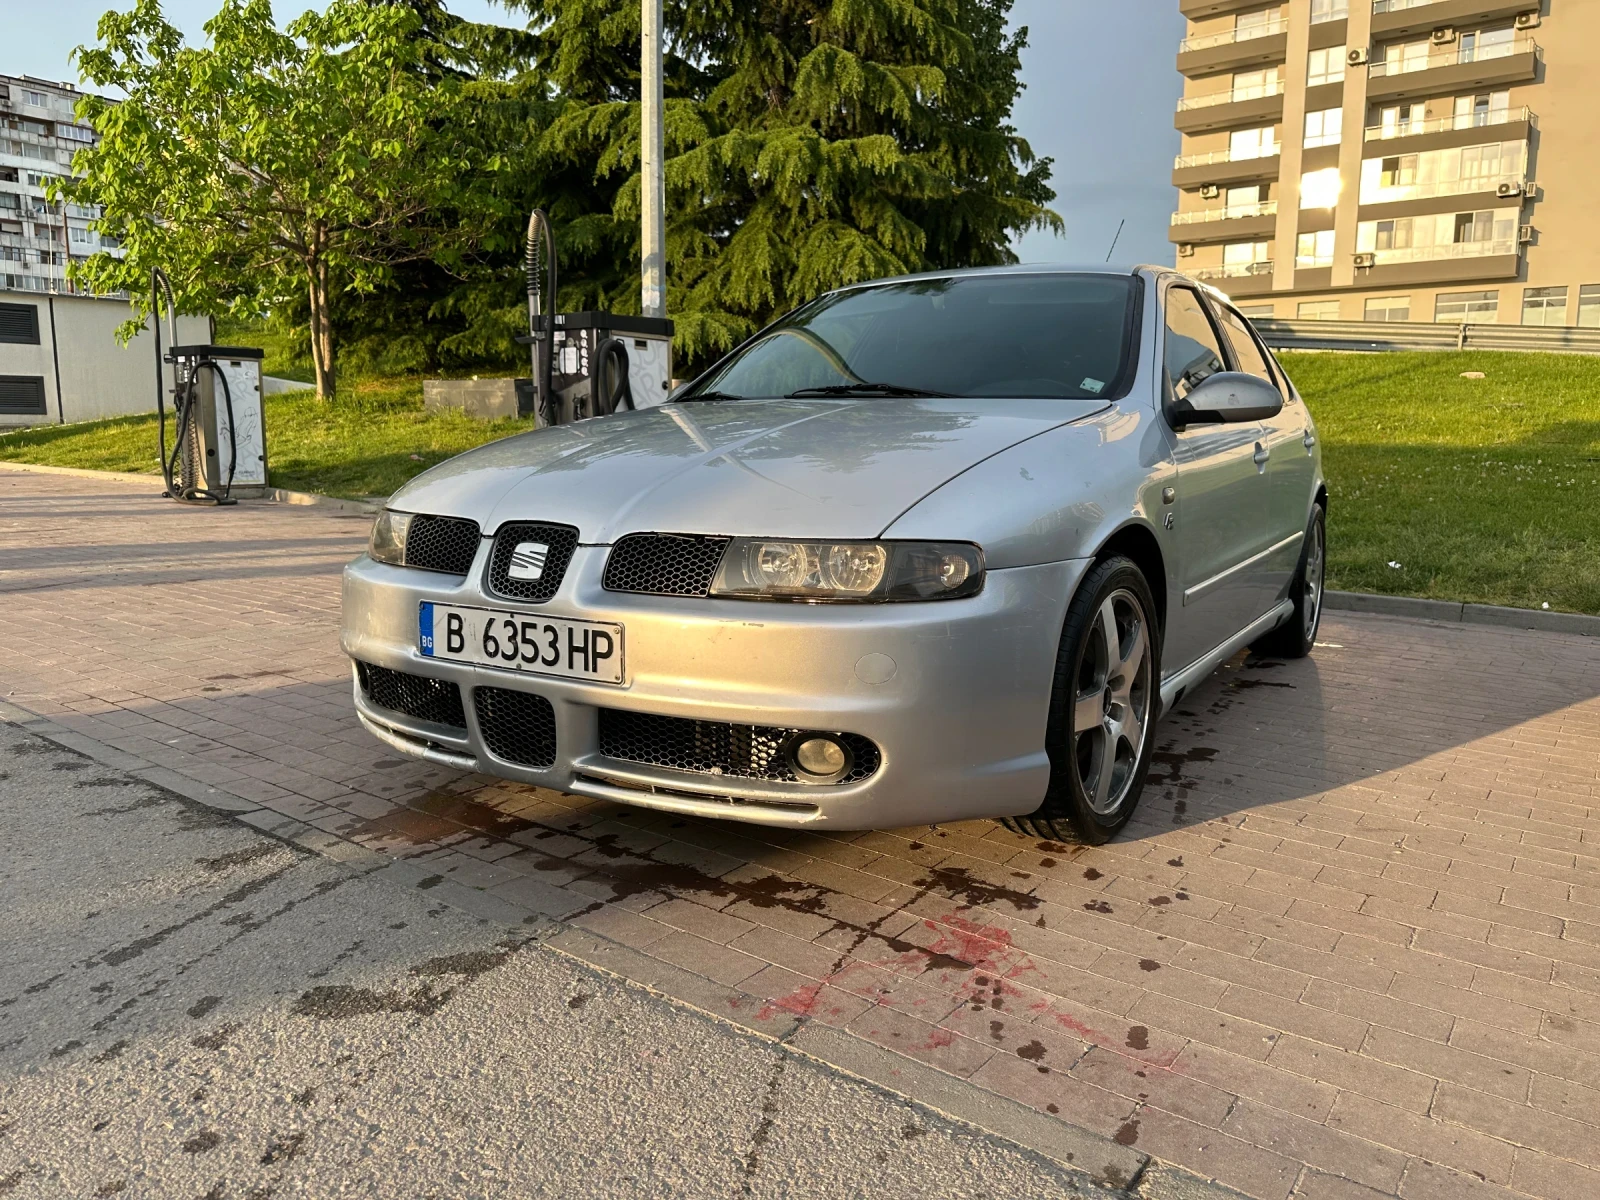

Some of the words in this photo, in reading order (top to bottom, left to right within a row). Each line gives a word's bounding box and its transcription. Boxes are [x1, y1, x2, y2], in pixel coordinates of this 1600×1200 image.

[421, 635, 433, 648] BG
[446, 612, 465, 653] B
[482, 617, 560, 666] 6353
[567, 626, 614, 673] HP
